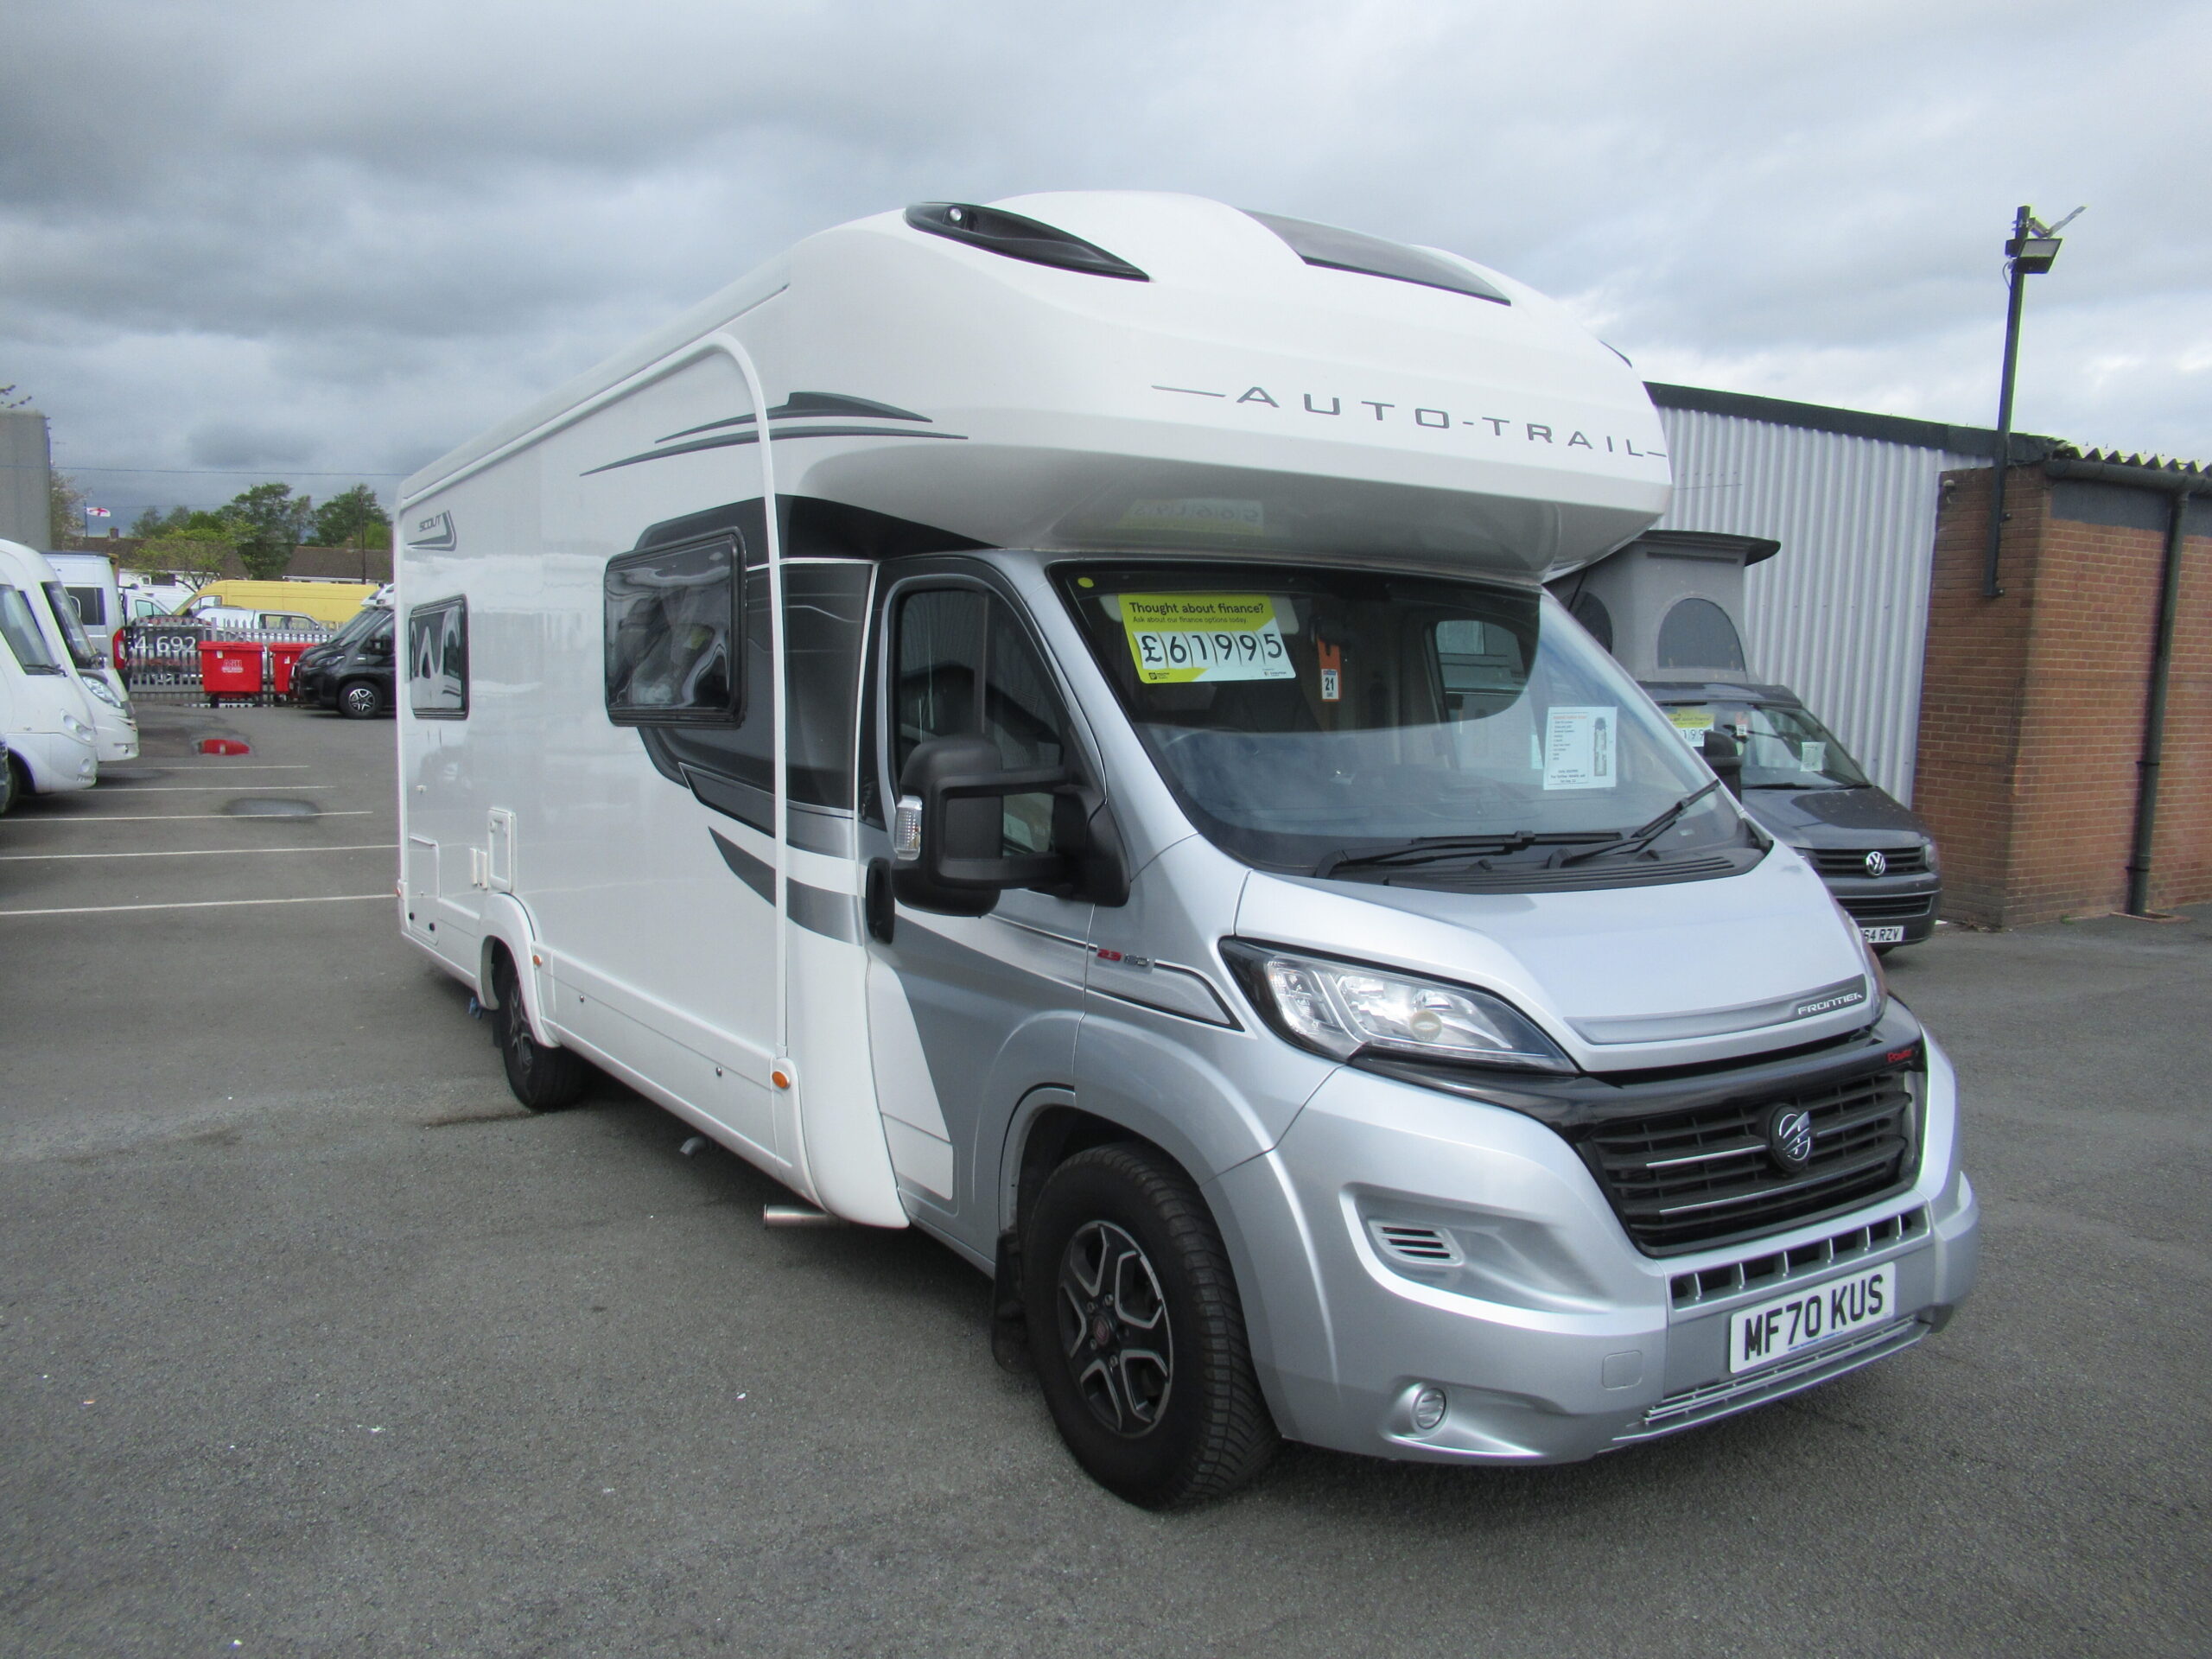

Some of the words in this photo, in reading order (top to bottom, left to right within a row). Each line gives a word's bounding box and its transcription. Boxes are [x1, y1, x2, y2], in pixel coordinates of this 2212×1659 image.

[1236, 385, 1644, 458] AUTO-TRAIL
[418, 514, 442, 532] SCOUT
[1128, 601, 1179, 615] Thought
[1182, 602, 1215, 613] about
[1217, 602, 1264, 613] finance?
[1205, 616, 1228, 625] options
[1141, 632, 1283, 664] £61995
[1325, 677, 1334, 691] 21
[1797, 992, 1862, 1015] FRONTIER
[1744, 1294, 1822, 1362] MF70
[1831, 1274, 1884, 1330] KUS
